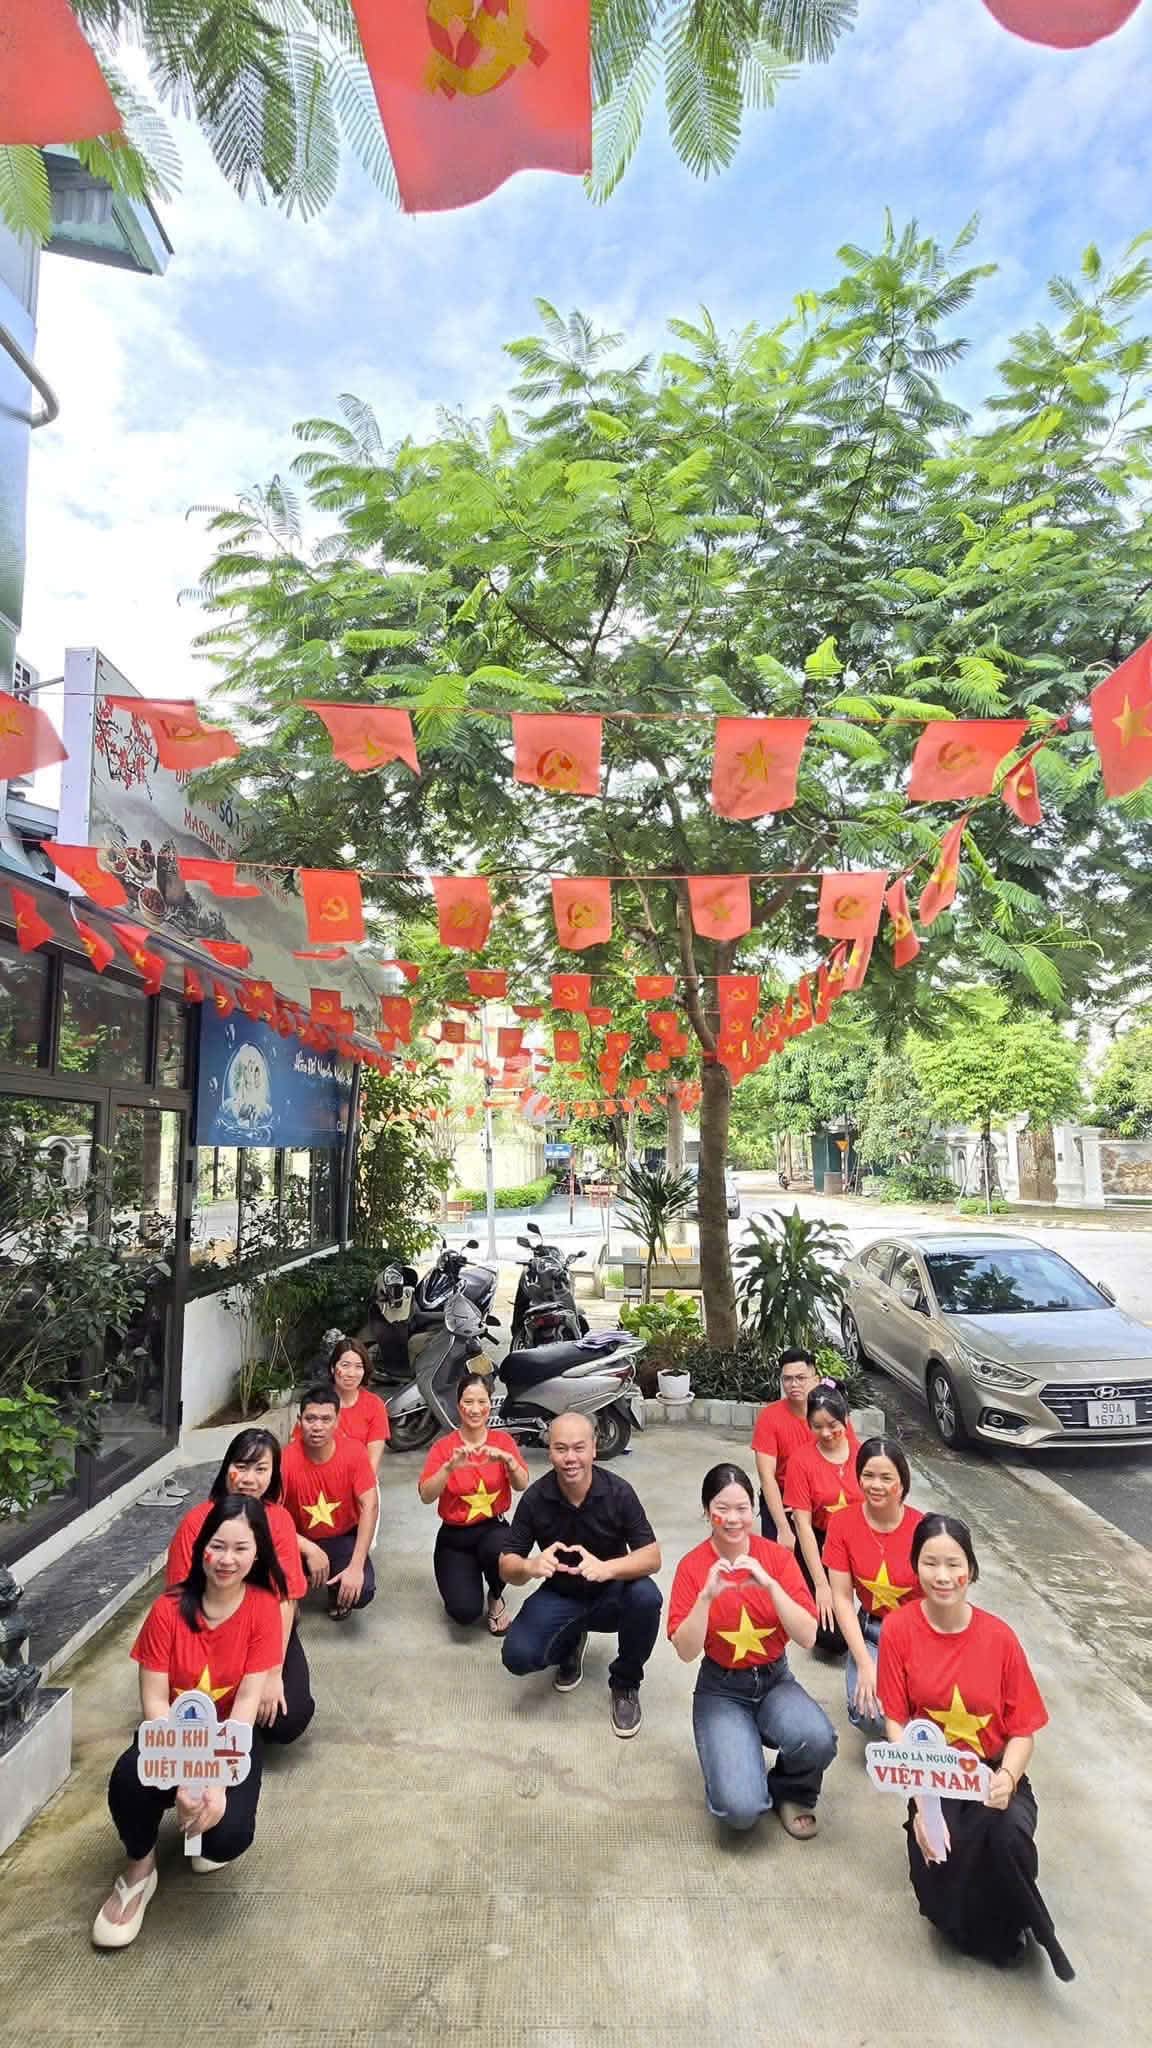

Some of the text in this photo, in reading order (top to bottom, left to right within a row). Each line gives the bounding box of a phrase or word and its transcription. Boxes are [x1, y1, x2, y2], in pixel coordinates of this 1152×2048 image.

[184, 807, 226, 854] MASSAGE
[1102, 1403, 1121, 1414] 90A
[144, 1756, 220, 1782] VIỆT NAM
[873, 1763, 982, 1793] VIỆT NAM
